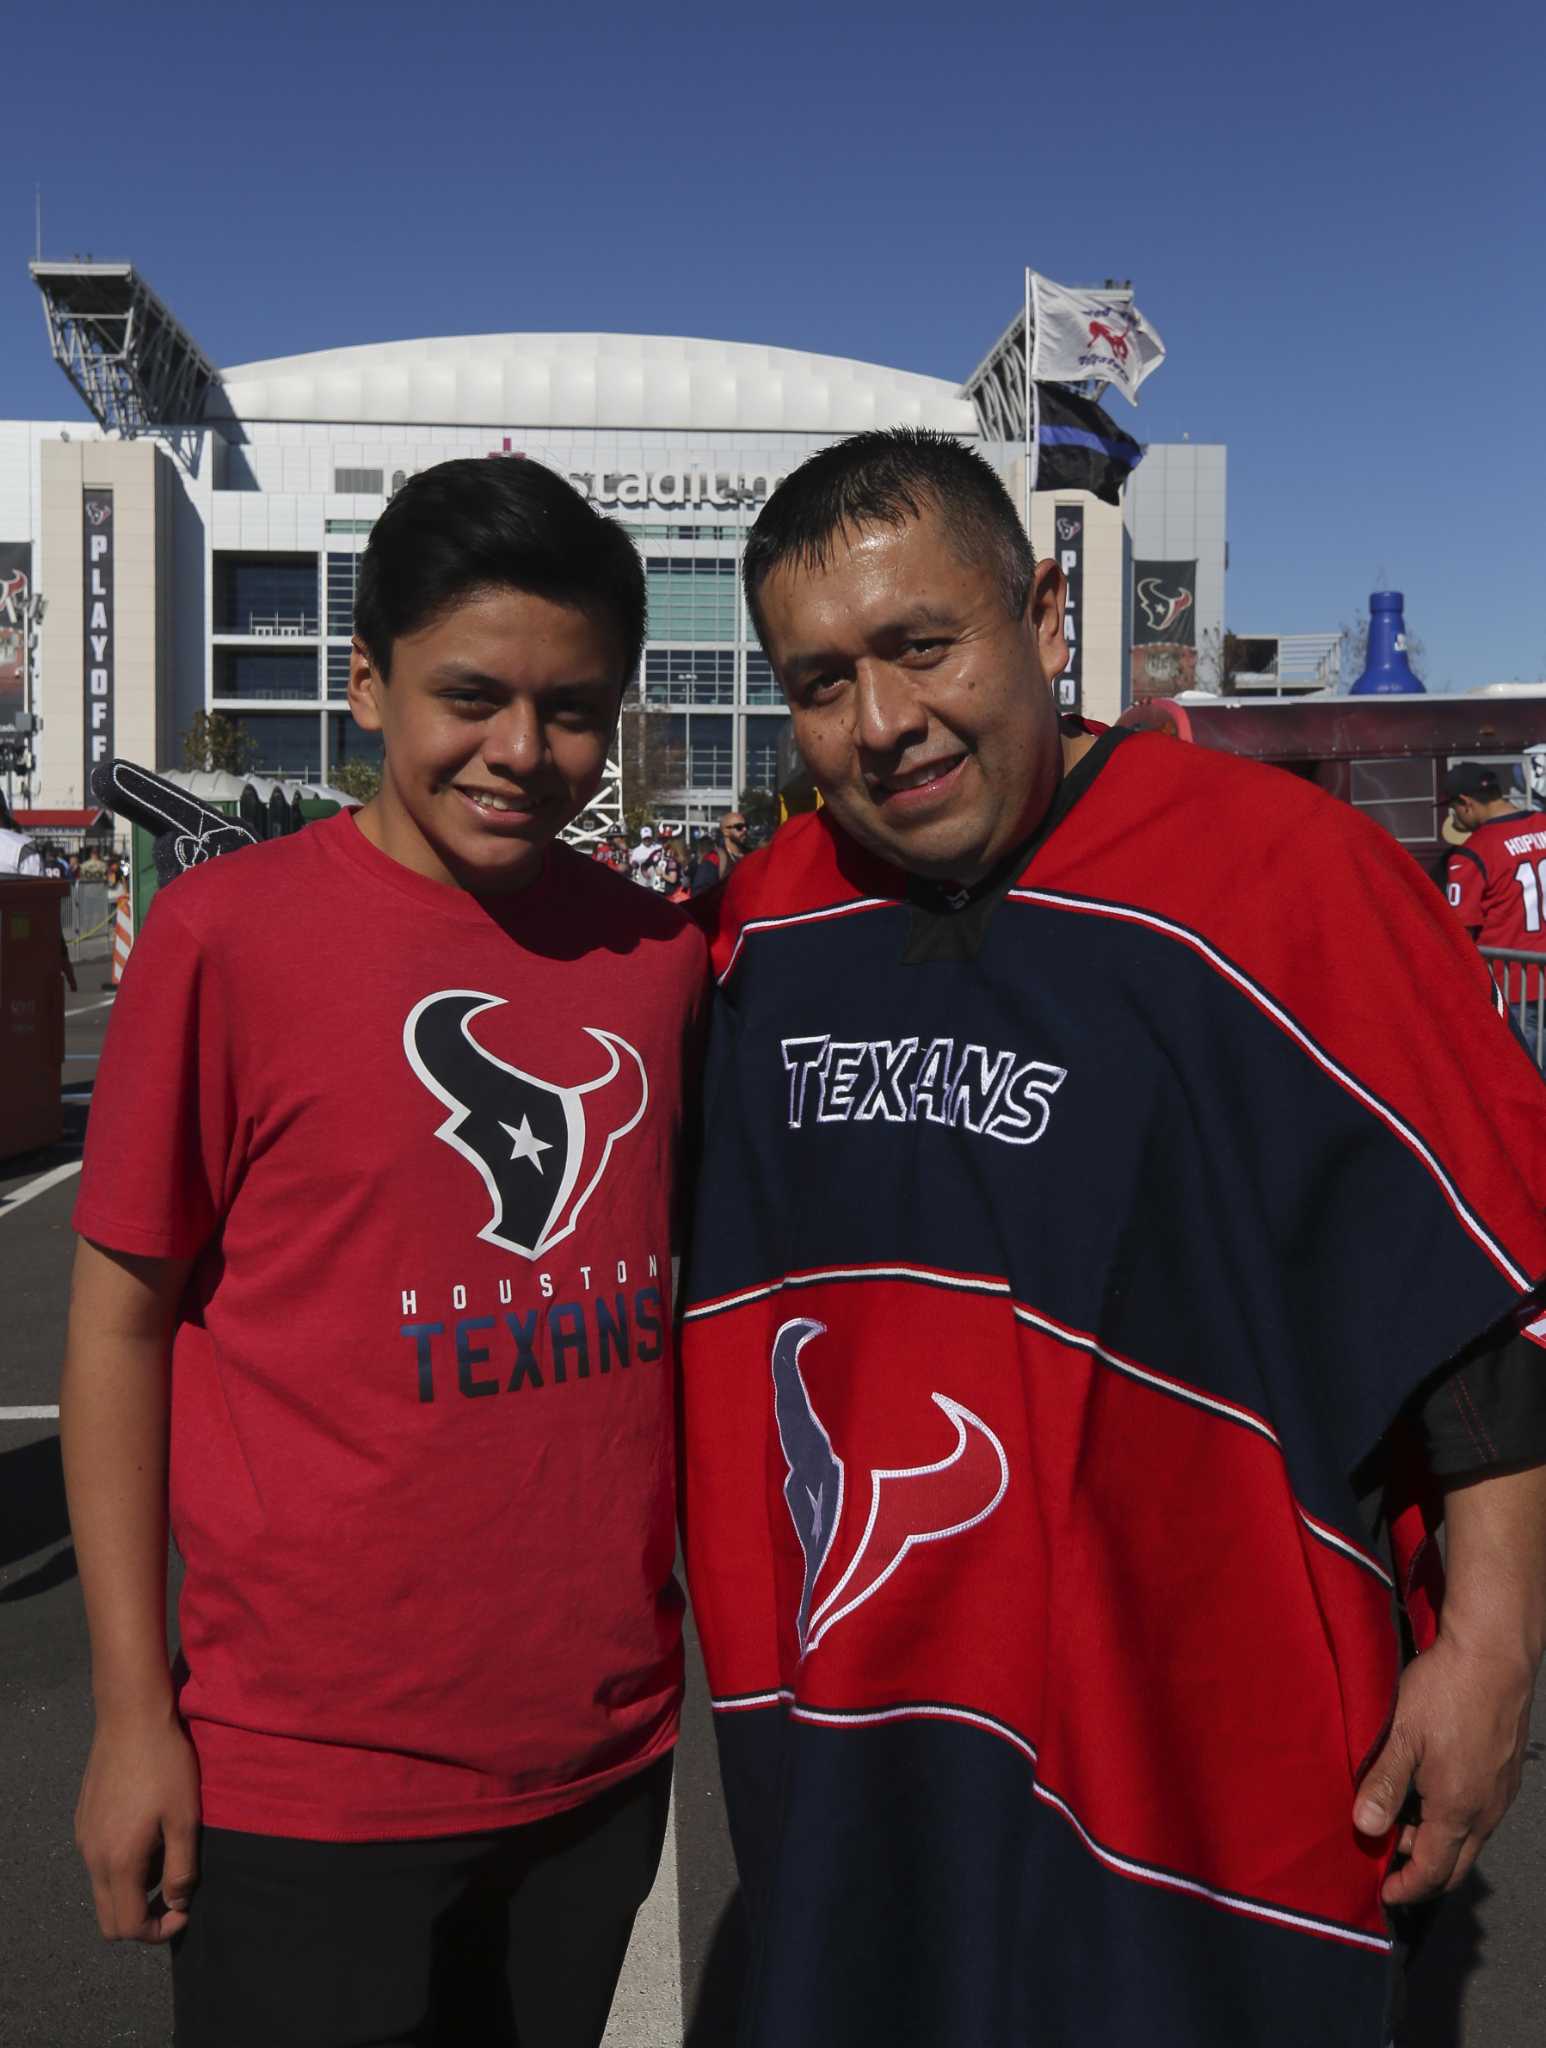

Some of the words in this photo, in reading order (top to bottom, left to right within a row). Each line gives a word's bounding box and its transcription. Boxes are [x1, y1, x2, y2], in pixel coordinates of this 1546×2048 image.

[90, 534, 108, 762] PLAYOFF
[781, 1034, 1068, 1144] TEXANS
[402, 1254, 657, 1315] HOUSTON
[400, 1286, 664, 1403] TEXANS
